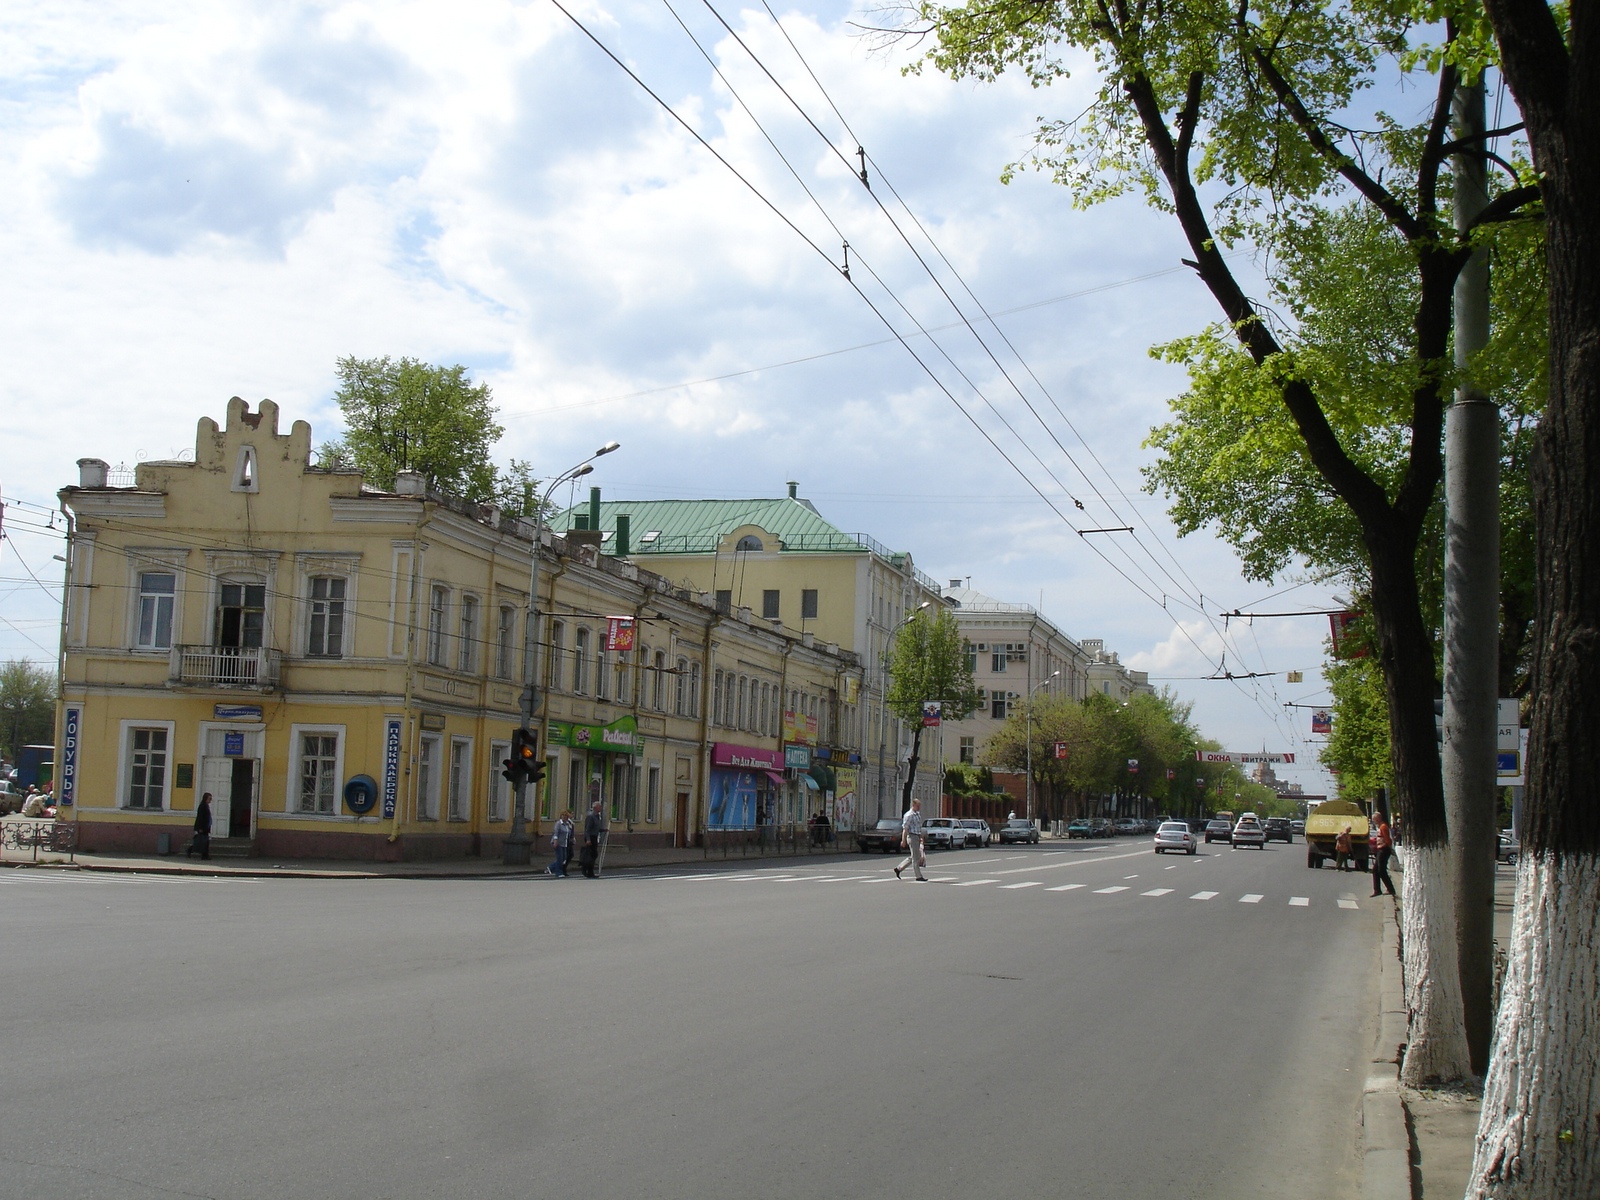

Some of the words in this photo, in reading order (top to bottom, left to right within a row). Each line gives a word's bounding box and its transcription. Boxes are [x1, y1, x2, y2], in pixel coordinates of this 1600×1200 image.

[64, 723, 77, 790] ОБУВЬ
[385, 728, 398, 812] ПАРИКМАХЕРСКАЯ
[791, 750, 808, 764] АПТЕКА
[1207, 754, 1231, 762] ОКНА
